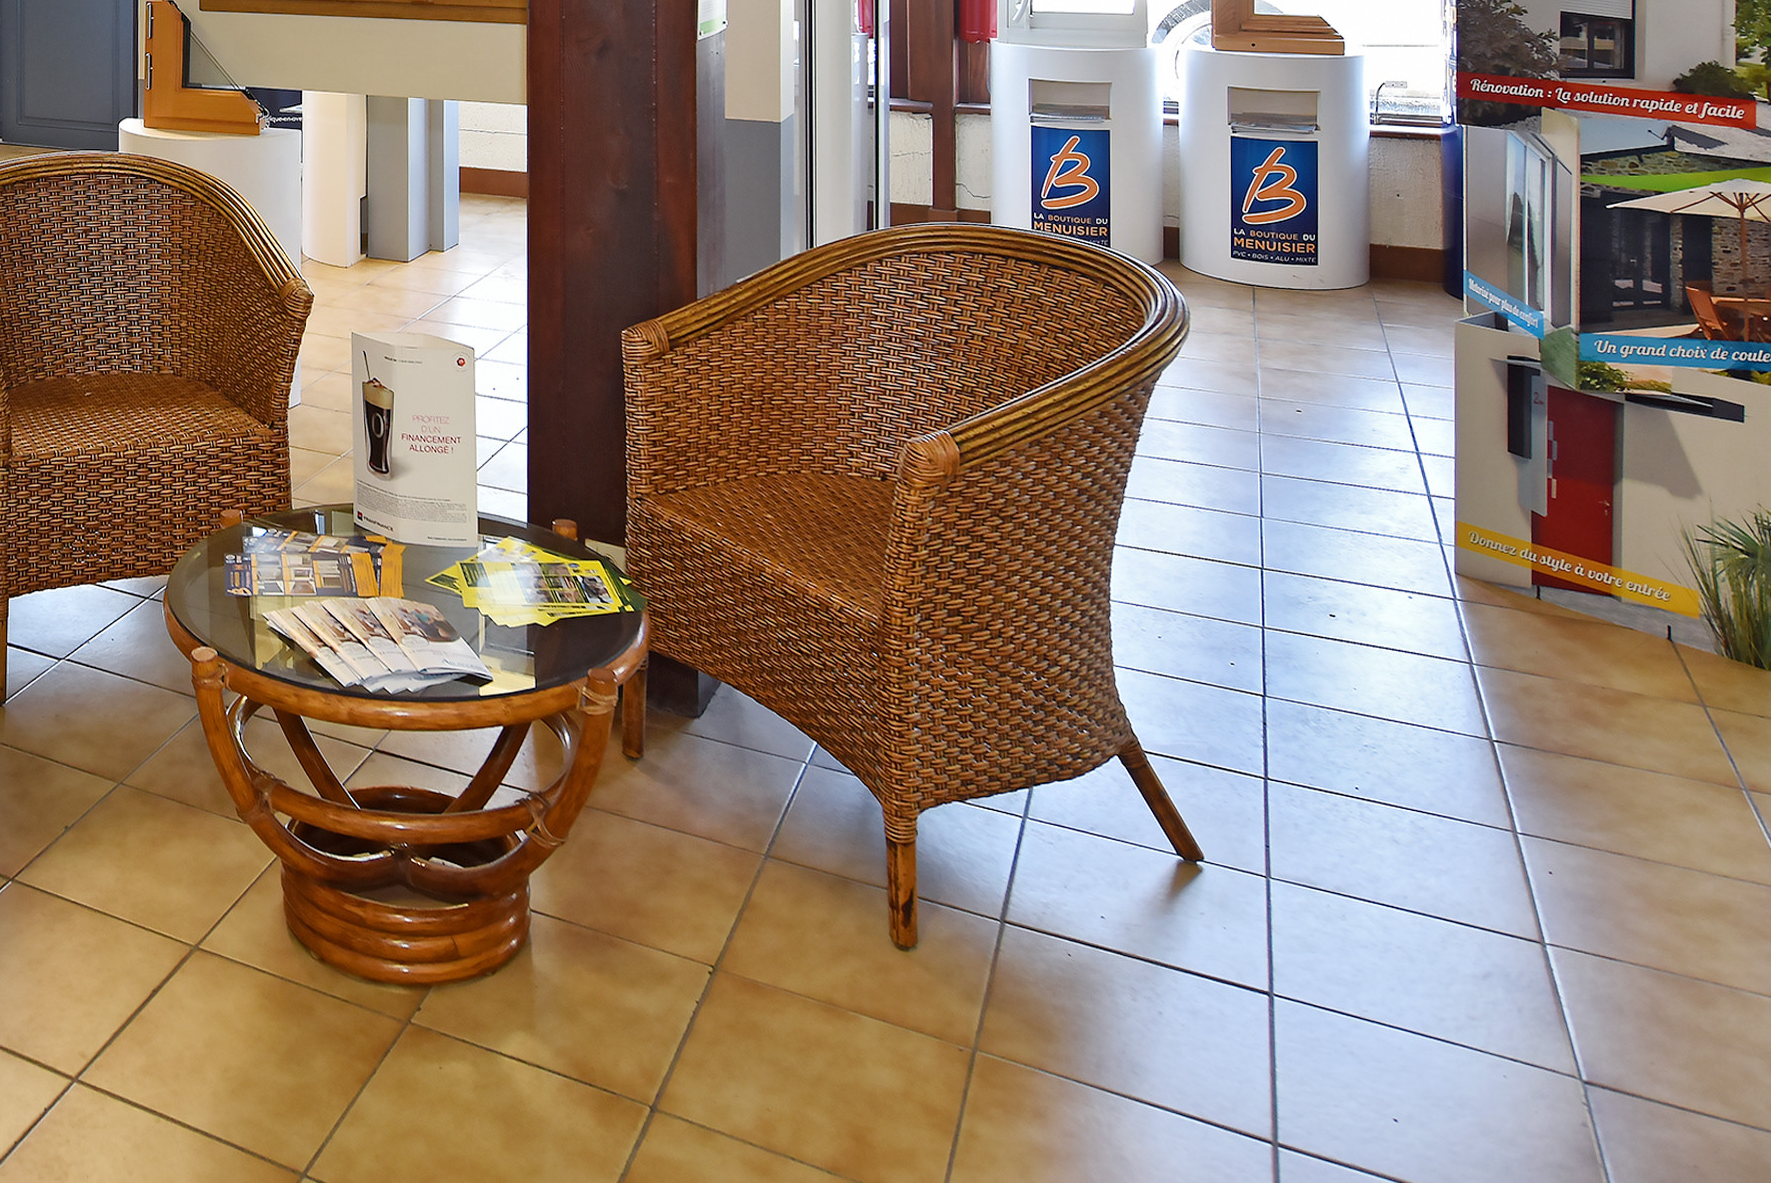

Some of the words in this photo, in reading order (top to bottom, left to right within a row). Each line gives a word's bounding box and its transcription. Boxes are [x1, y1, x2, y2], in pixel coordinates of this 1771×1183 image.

[1470, 78, 1545, 98] Rénovation
[1554, 87, 1571, 104] La
[1573, 90, 1630, 107] solution
[1632, 98, 1682, 114] rapide
[1684, 102, 1699, 114] et
[1698, 100, 1745, 120] facile
[1048, 214, 1091, 224] BOUTIQUE
[1034, 221, 1108, 236] MENUISIER
[1250, 230, 1298, 240] BOUTIQUE
[1234, 237, 1315, 253] MENUISIER
[1594, 340, 1617, 354] Un
[1620, 345, 1666, 358] grand
[1669, 346, 1707, 359] choix
[1710, 348, 1728, 360] de
[1732, 350, 1771, 362] coule
[401, 433, 462, 444] FINANCEMENT
[1469, 531, 1517, 556] Donnez
[1520, 548, 1537, 563] du
[1539, 554, 1572, 572] style
[1574, 564, 1585, 576] à
[1588, 568, 1623, 586] votre
[1626, 581, 1671, 601] entrée
